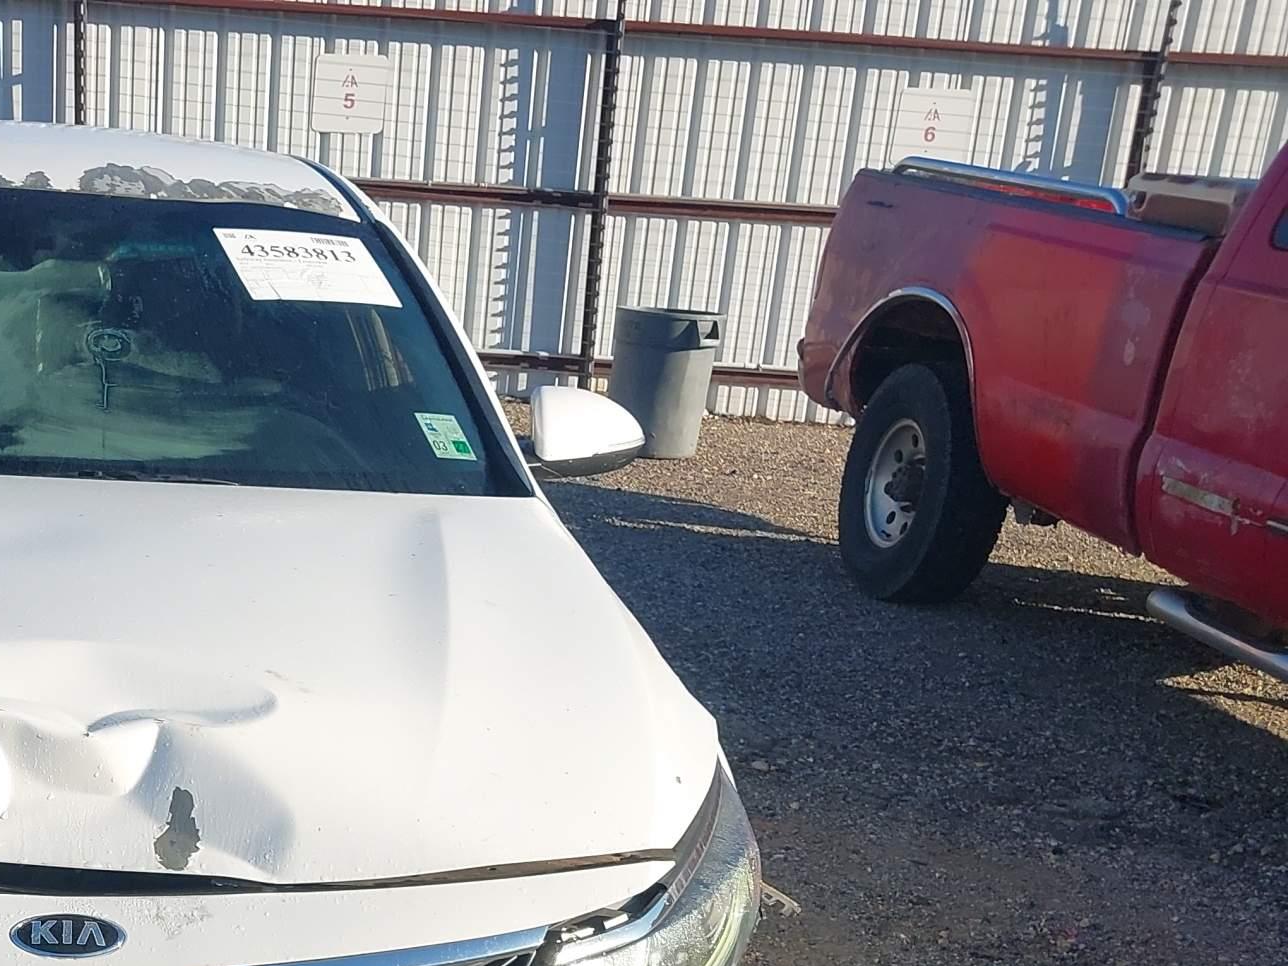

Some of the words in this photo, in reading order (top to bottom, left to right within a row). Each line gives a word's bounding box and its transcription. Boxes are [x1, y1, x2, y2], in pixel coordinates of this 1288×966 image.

[343, 93, 355, 109] 5
[924, 126, 936, 142] 6
[241, 244, 357, 263] 43583813
[432, 440, 448, 451] 03
[31, 919, 106, 946] KIA
